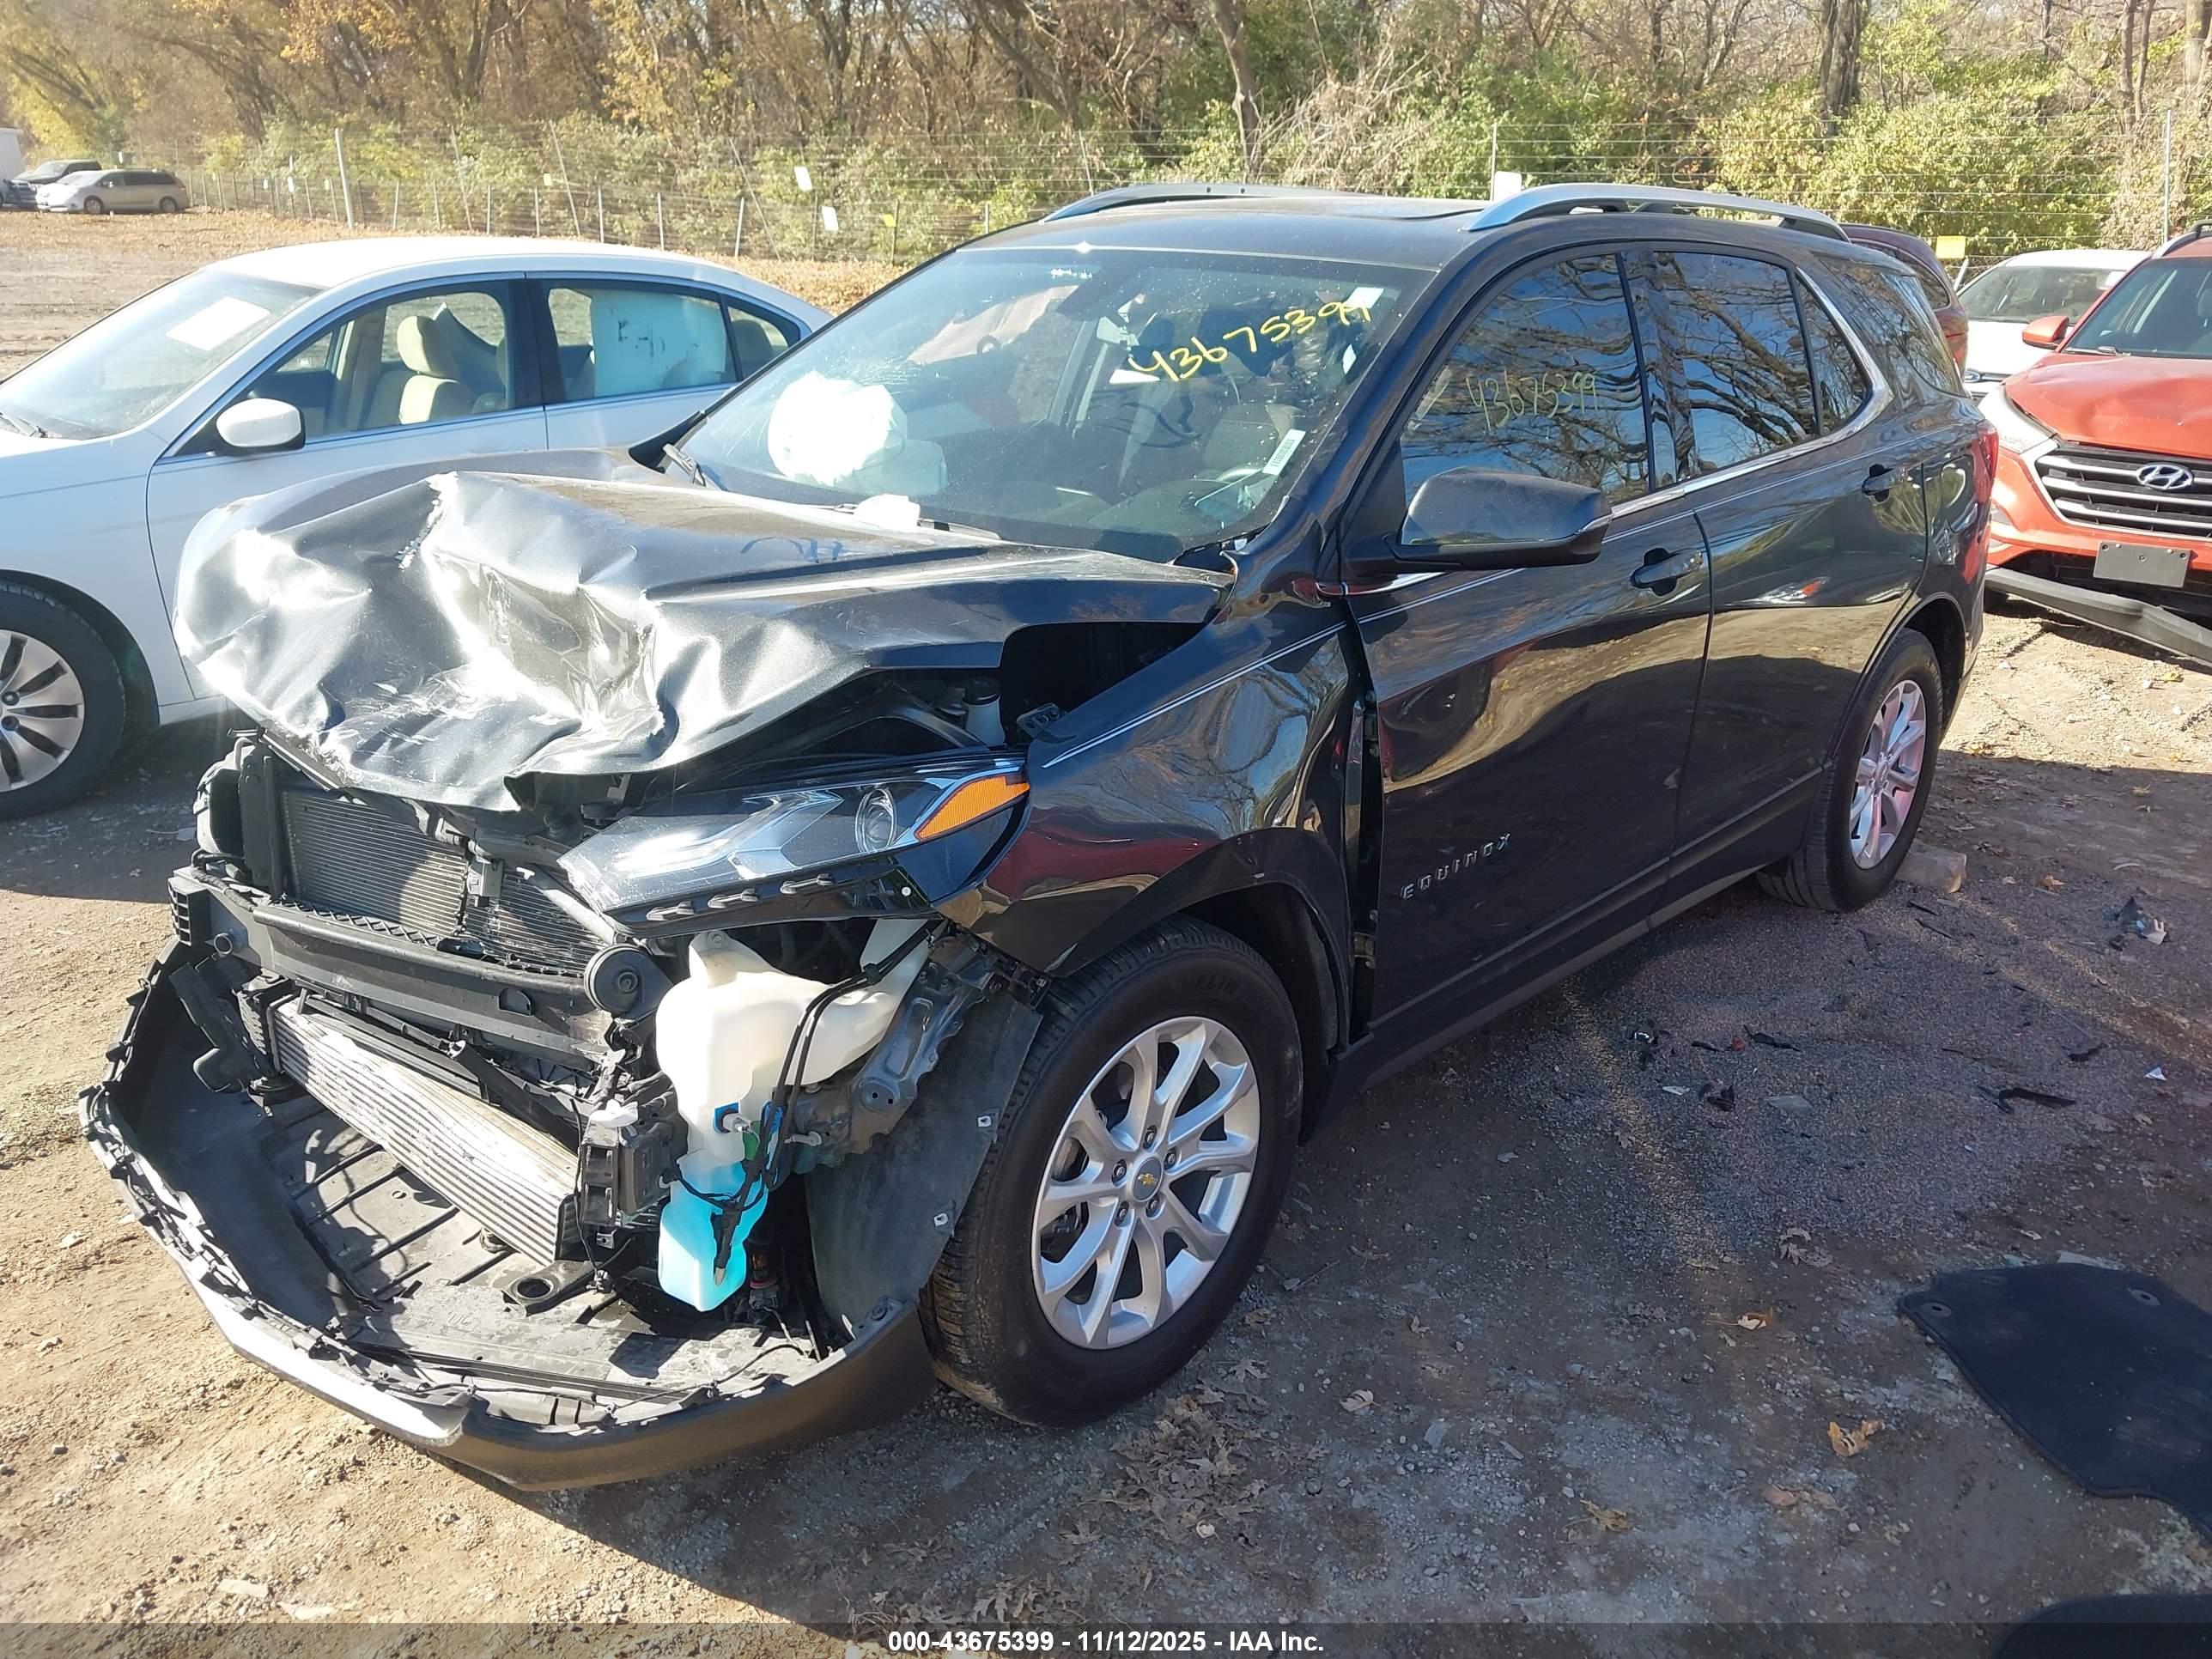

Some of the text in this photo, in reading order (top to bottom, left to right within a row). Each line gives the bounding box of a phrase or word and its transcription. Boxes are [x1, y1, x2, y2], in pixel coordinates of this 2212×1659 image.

[1127, 301, 1371, 382] 43675399
[1466, 368, 1599, 433] 43675399
[1401, 833, 1511, 900] EQUINOX
